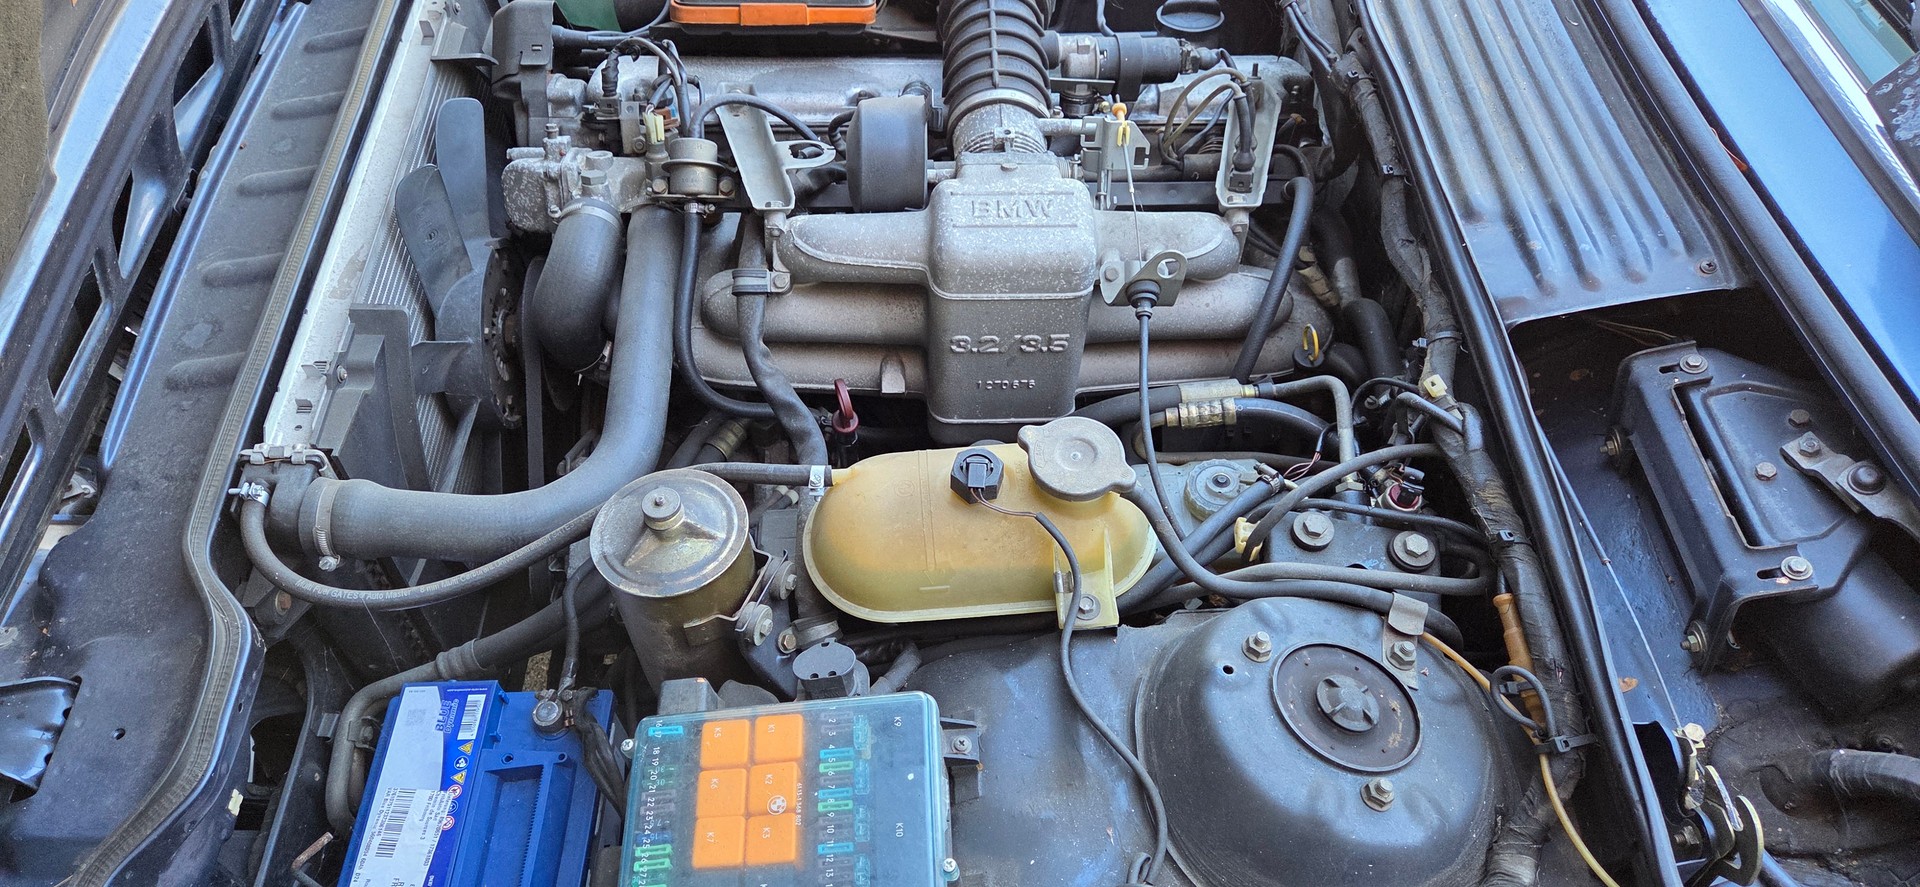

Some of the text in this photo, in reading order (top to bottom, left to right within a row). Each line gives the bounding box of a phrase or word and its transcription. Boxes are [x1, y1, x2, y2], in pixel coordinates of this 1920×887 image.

[971, 199, 1053, 219] BMW
[950, 333, 1070, 354] 3.2/3.5
[312, 585, 330, 596] Fuel
[366, 592, 384, 601] Auto
[434, 699, 452, 732] BLUE
[656, 720, 663, 728] 16
[894, 716, 901, 727] K9
[714, 727, 721, 738] K5
[768, 724, 775, 733] K1
[653, 746, 660, 755] 18
[652, 757, 659, 766] 19
[650, 770, 658, 781] 20
[765, 774, 773, 785] K2
[648, 785, 656, 793] 21
[710, 778, 719, 789] K6
[646, 797, 655, 807] 22
[645, 810, 654, 821] 23
[644, 825, 653, 835] 24
[762, 827, 771, 839] K3
[827, 825, 834, 834] 10
[896, 823, 904, 837] K10
[706, 832, 715, 843] K7
[642, 838, 651, 849] 25
[640, 852, 649, 864] 26
[826, 854, 833, 862] 12
[353, 872, 361, 882] D24
[639, 868, 648, 877] 27
[826, 869, 833, 877] 13
